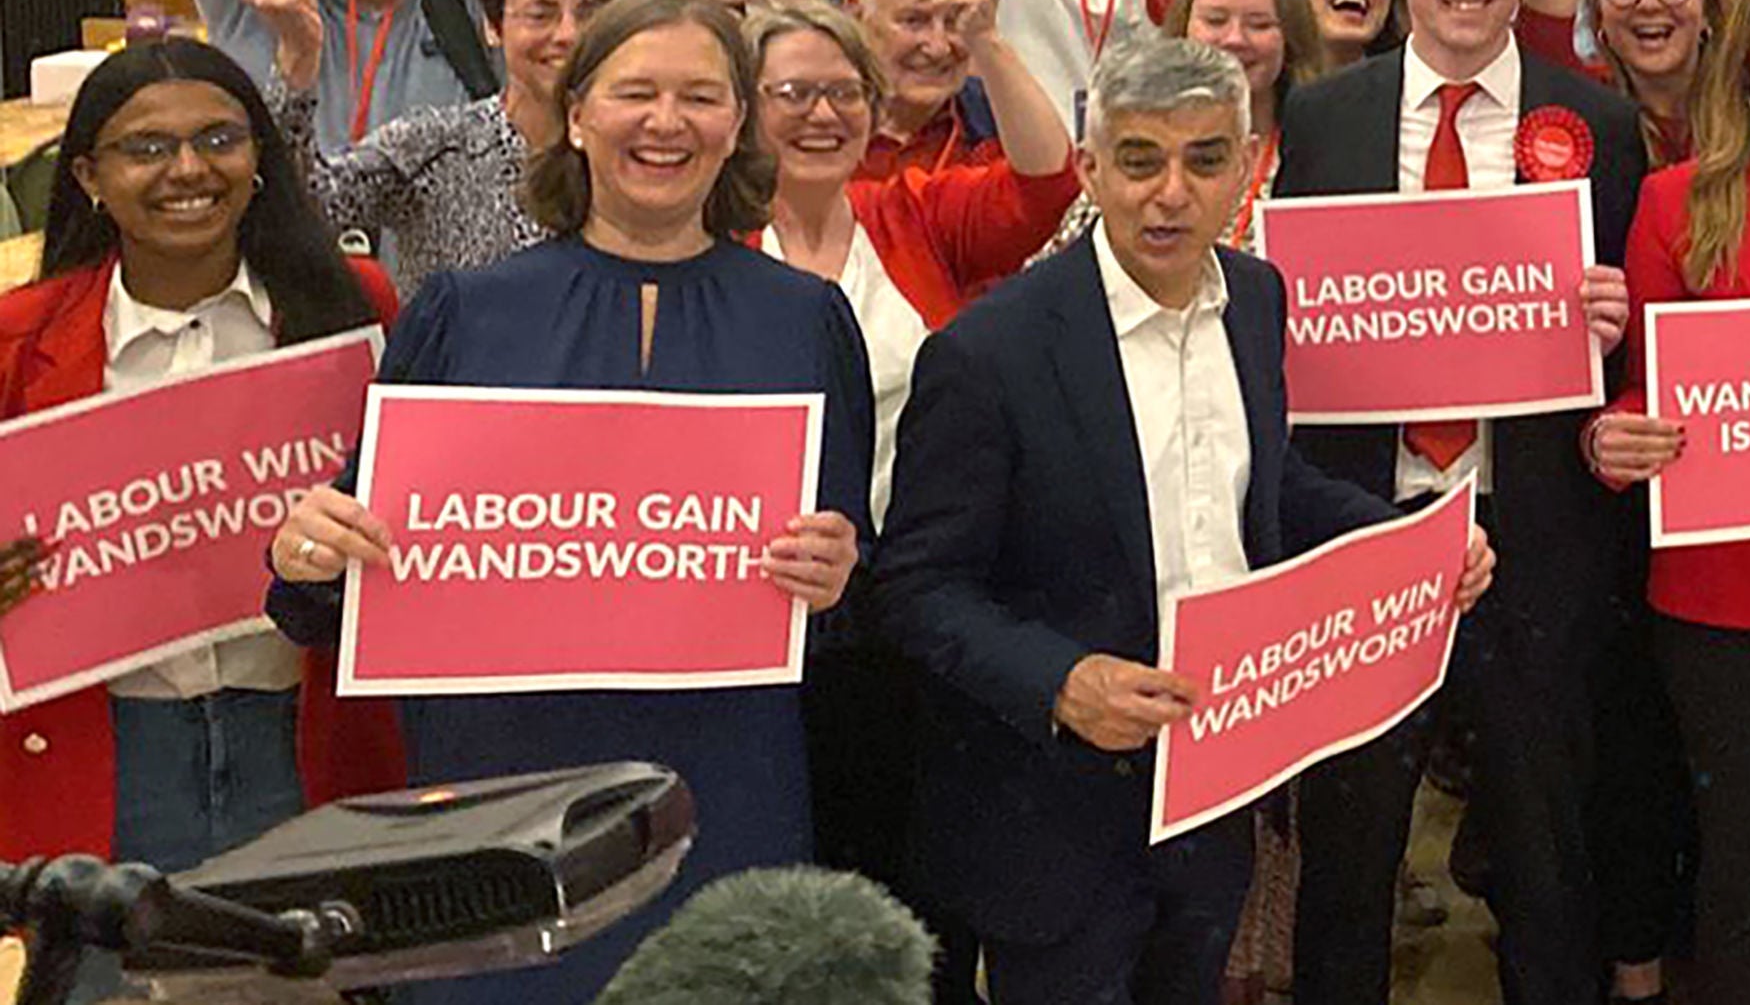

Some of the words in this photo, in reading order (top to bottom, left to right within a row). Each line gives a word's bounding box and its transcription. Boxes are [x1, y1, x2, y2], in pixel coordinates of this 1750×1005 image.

[1296, 268, 1448, 308] LABOUR
[1462, 263, 1555, 295] GAIN
[1287, 300, 1569, 346] WANDSWORTH
[242, 433, 345, 484] WIN
[408, 493, 617, 532] LABOUR
[637, 493, 761, 533] GAIN
[390, 541, 770, 582] WANDSWORTH
[1211, 608, 1355, 695] LABOUR
[1371, 572, 1442, 626] WIN
[1189, 601, 1448, 742] WANDSWORTH
